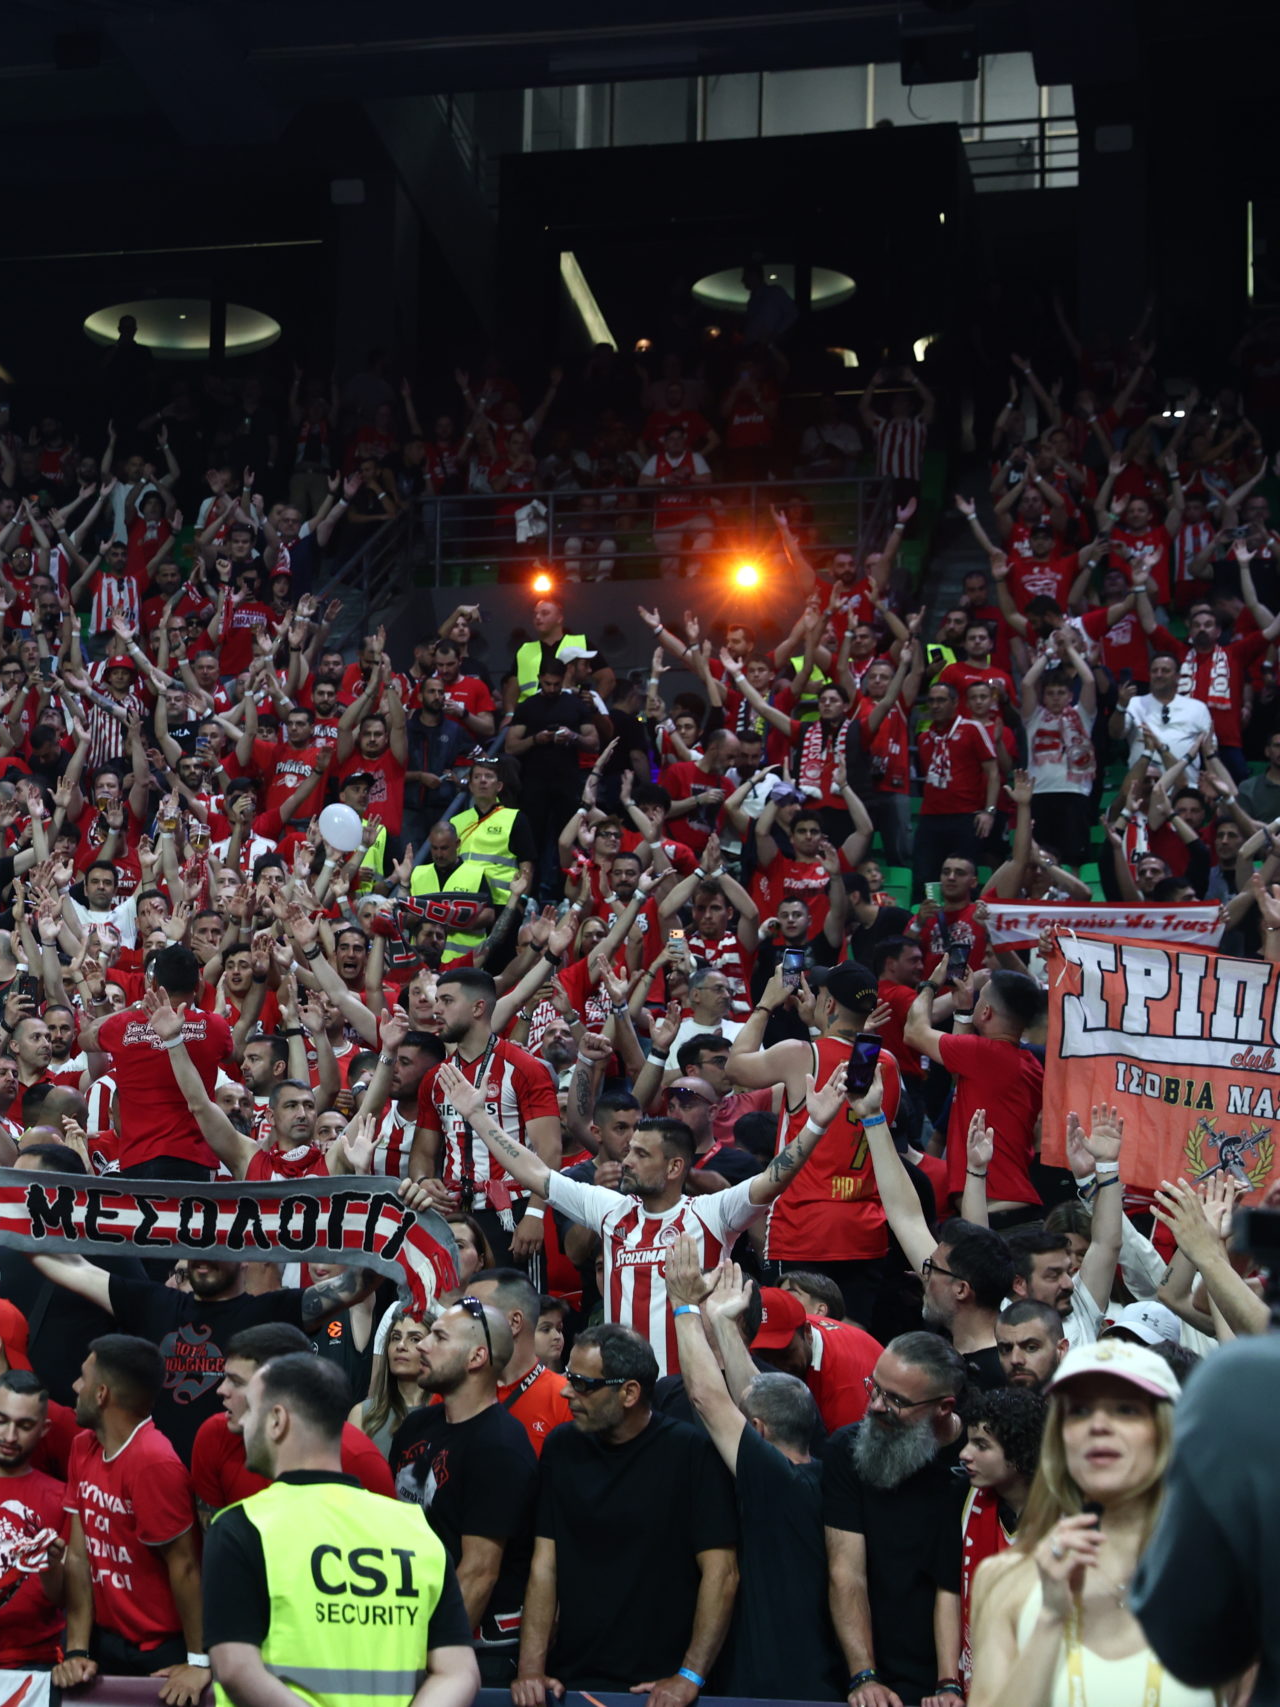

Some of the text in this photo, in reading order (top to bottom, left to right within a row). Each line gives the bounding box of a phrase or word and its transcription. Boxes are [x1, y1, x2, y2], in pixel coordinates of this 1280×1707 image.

[1161, 914, 1222, 939] Trust
[1055, 935, 1280, 1048] ΤΡΙΠ
[1230, 1048, 1278, 1071] club
[1115, 1061, 1216, 1112] ΙΣΟΒΙΑ
[616, 1247, 668, 1269] STOIXIMA
[310, 1544, 420, 1599] CSI
[314, 1601, 419, 1627] SECURITY
